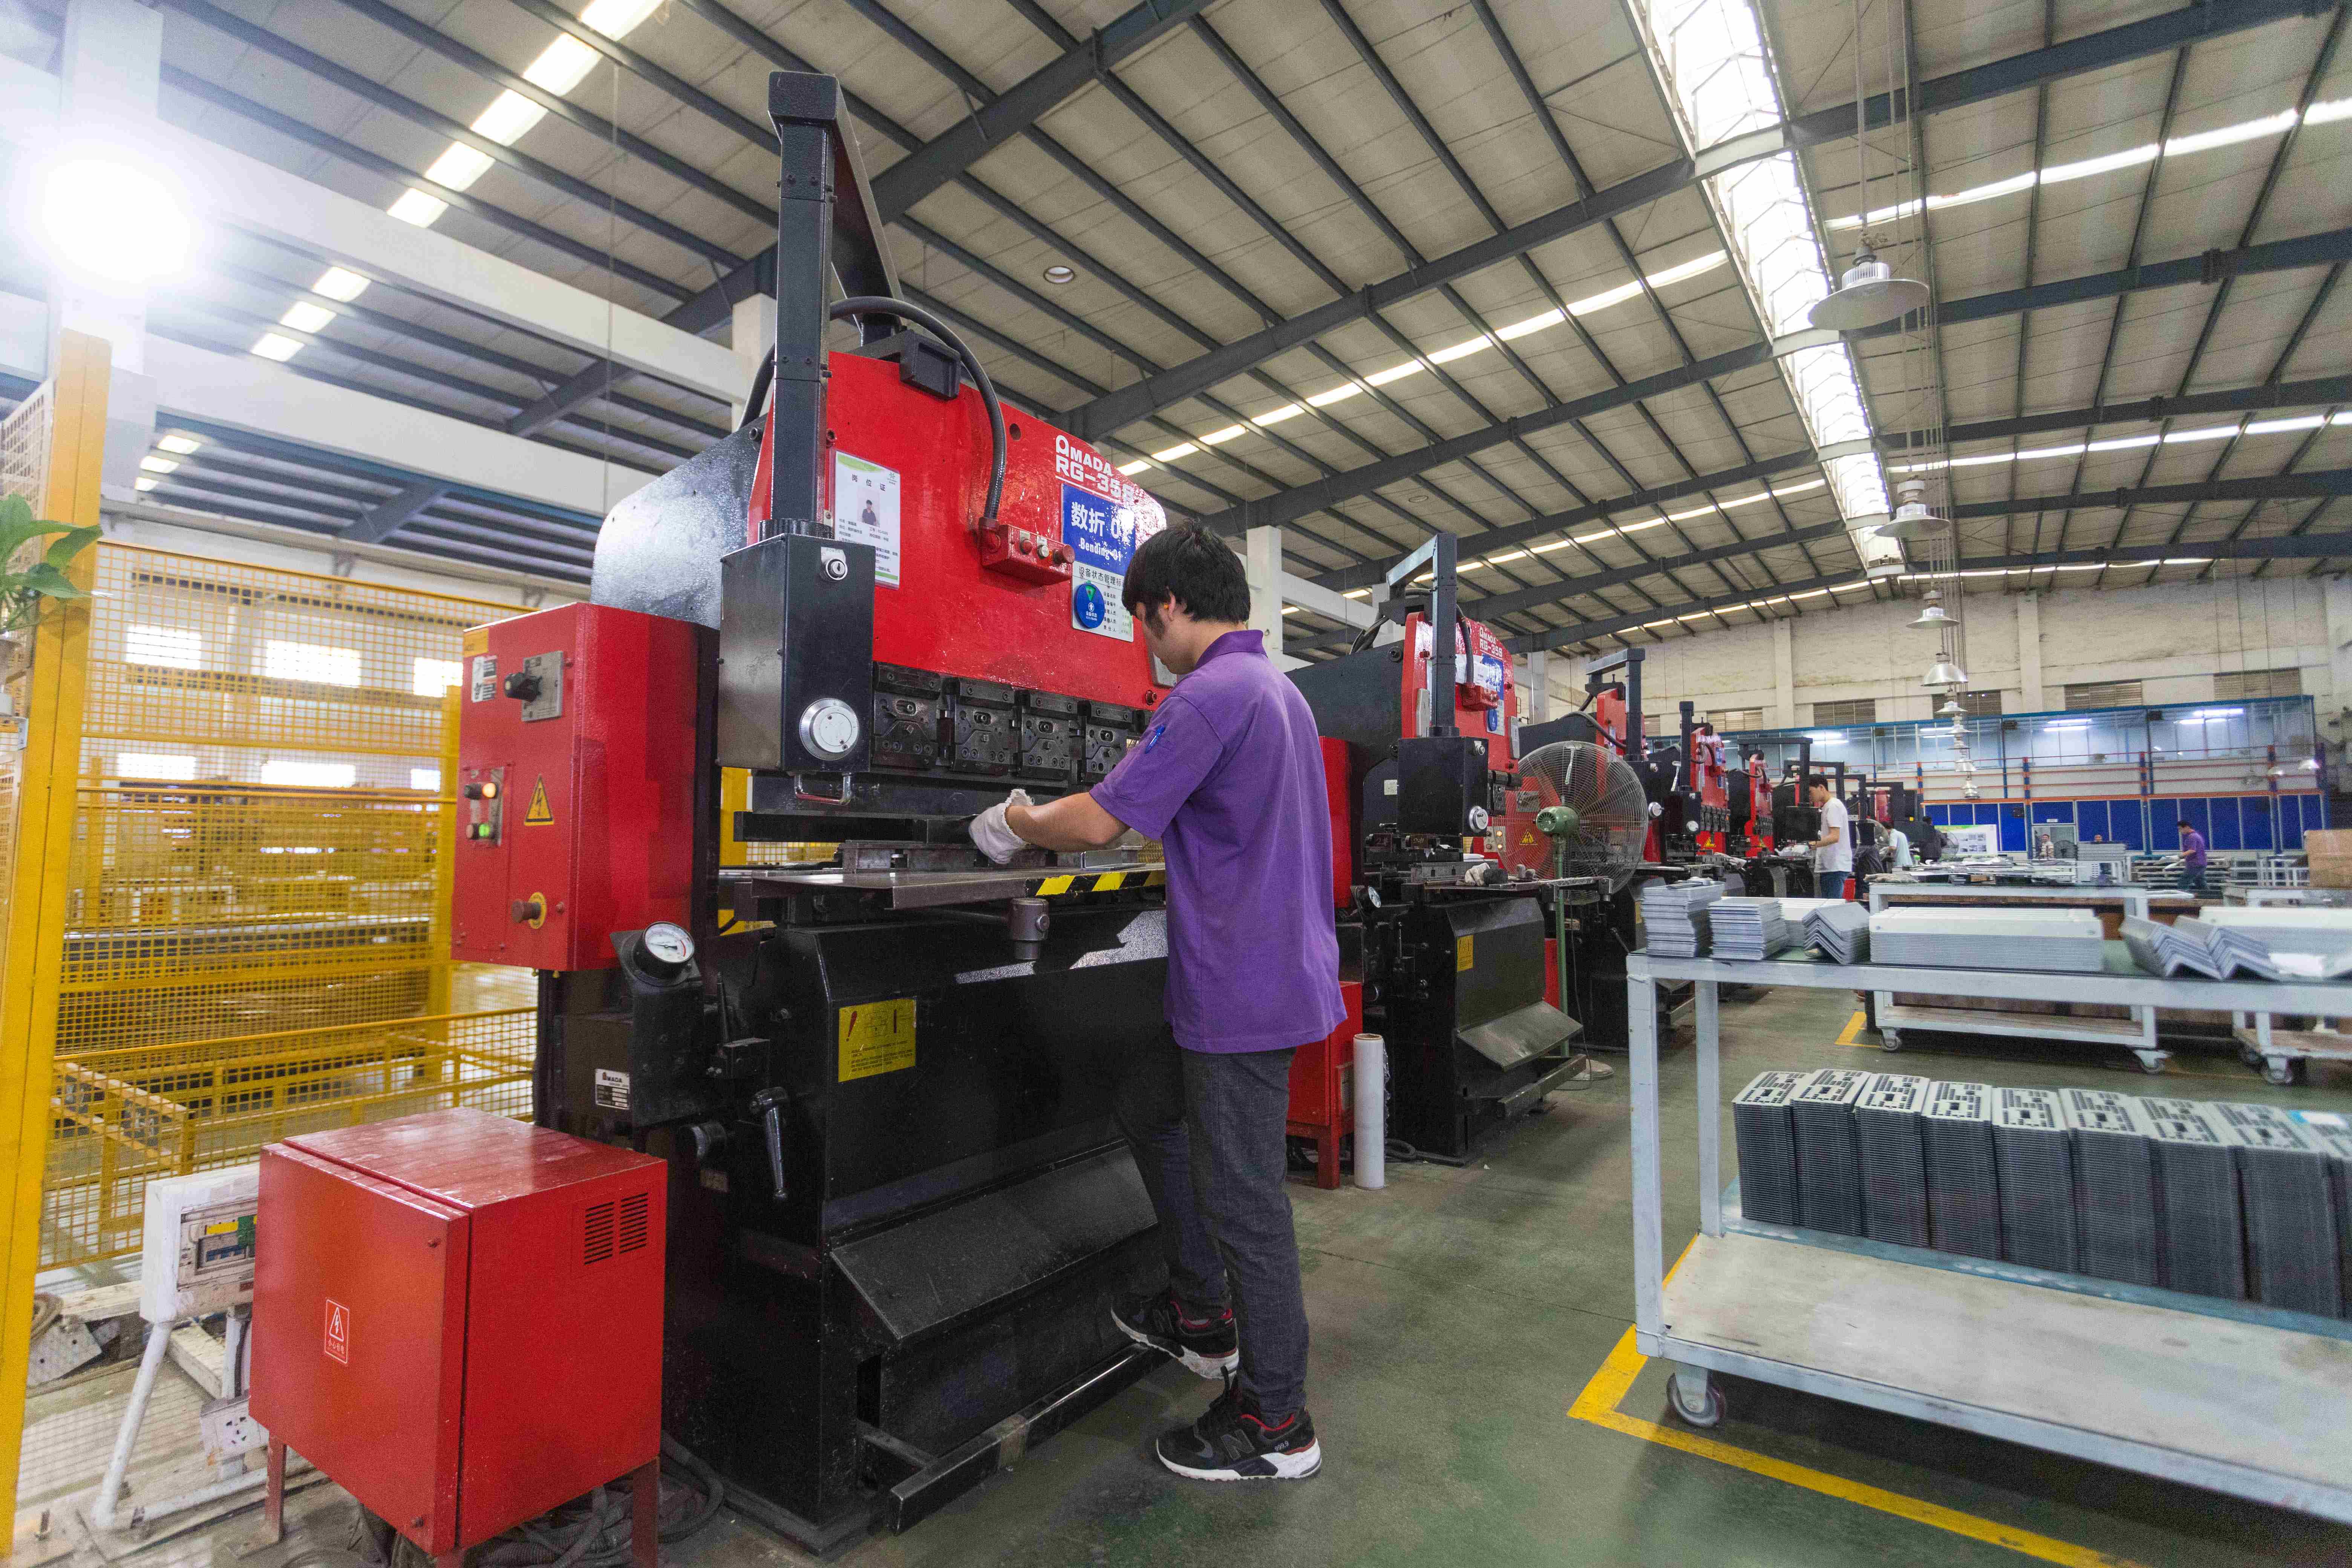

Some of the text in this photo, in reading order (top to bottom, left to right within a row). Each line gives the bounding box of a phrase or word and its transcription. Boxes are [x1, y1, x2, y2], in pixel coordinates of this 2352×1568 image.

[1056, 435, 1112, 476] AMADA
[1071, 501, 1105, 537] 数折
[1079, 566, 1123, 587] 设备状态管理标
[1274, 1441, 1289, 1451] 999.9
